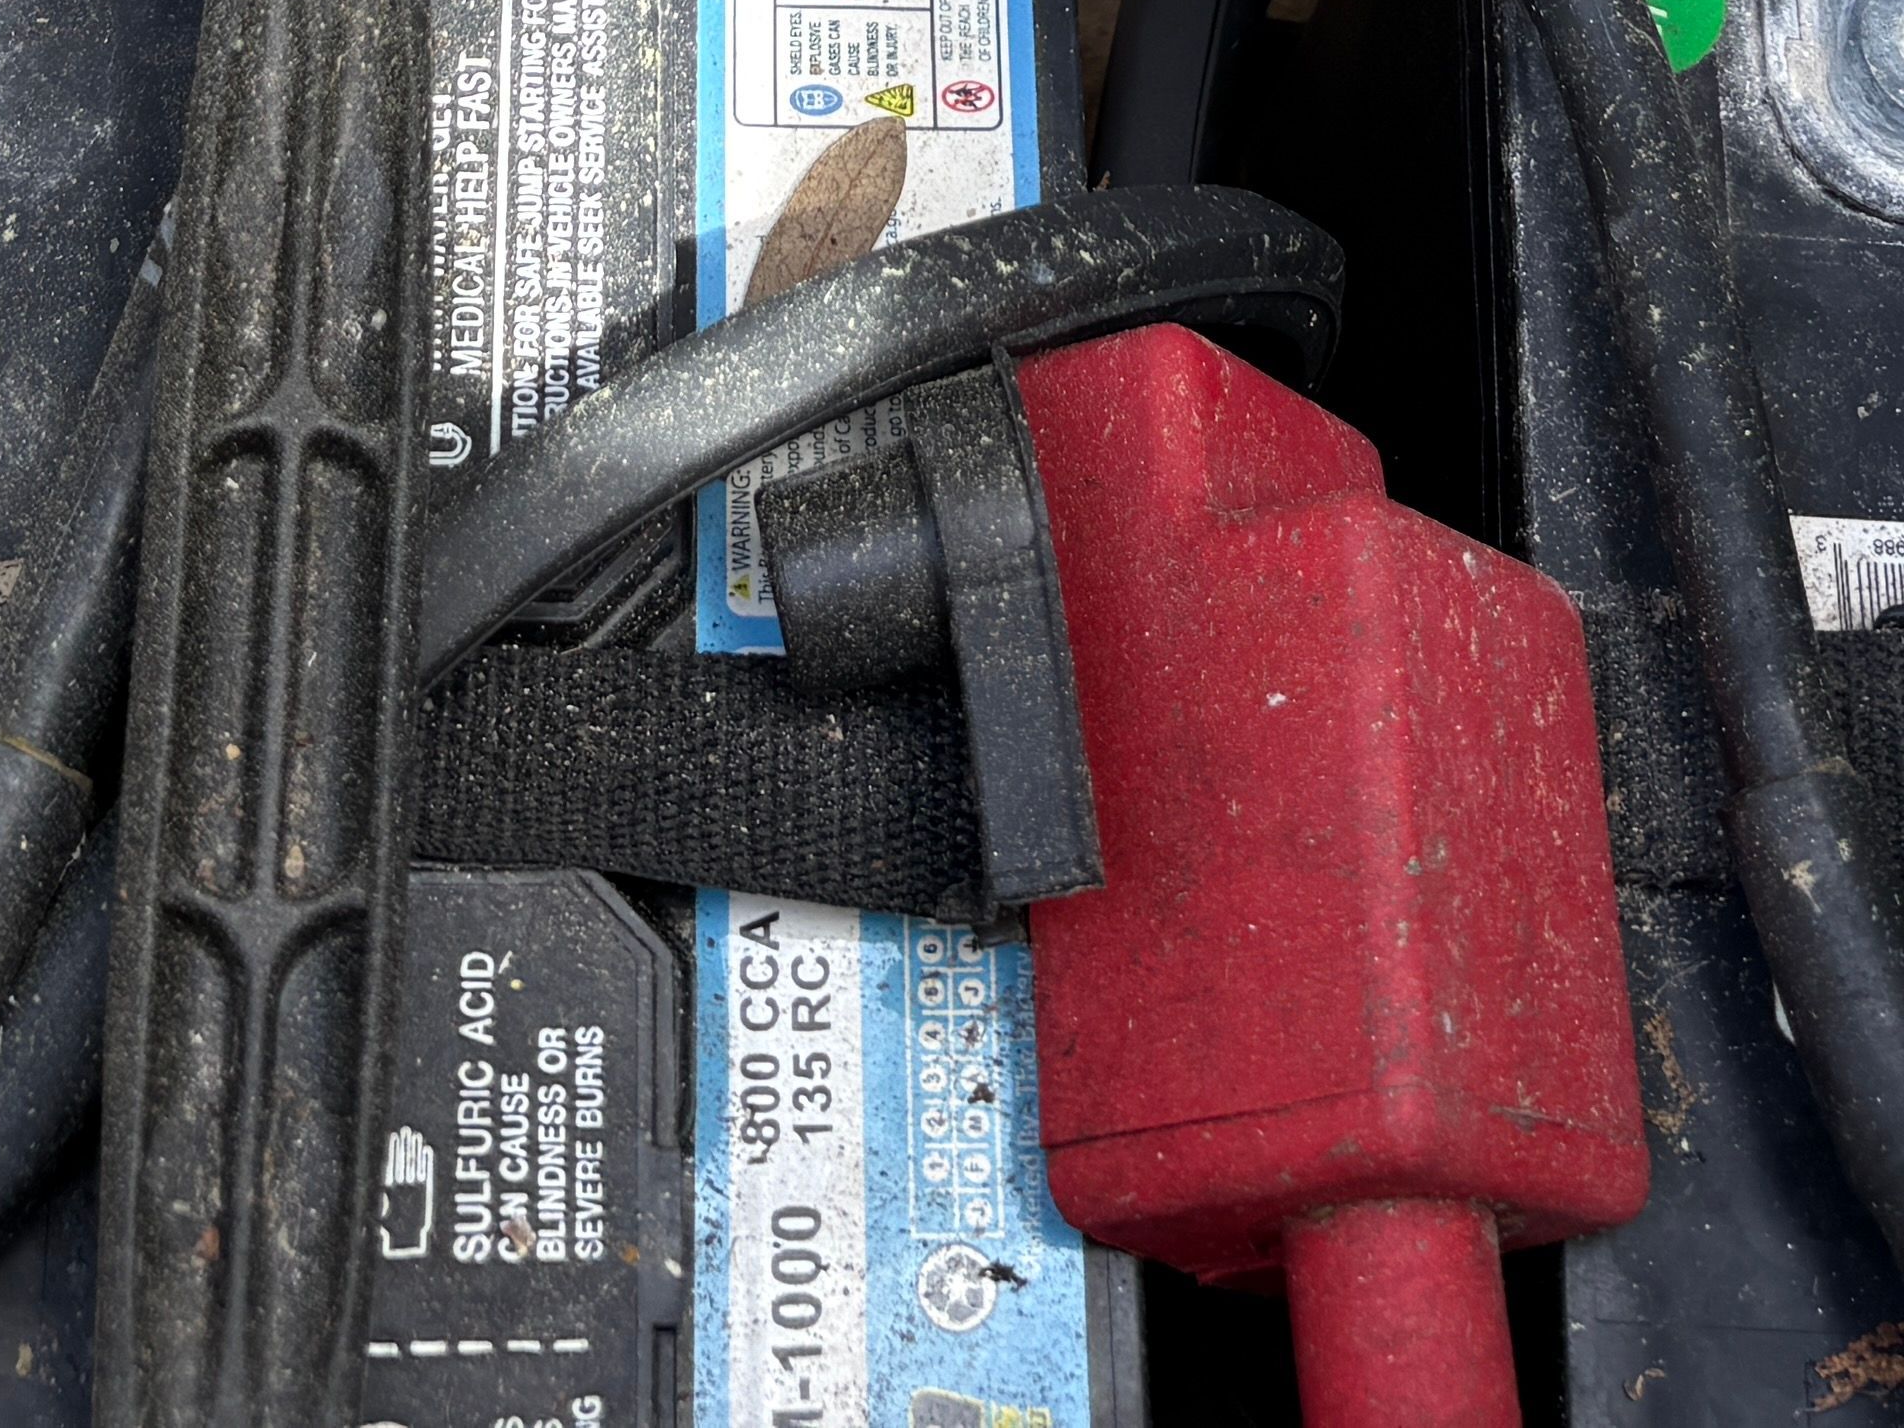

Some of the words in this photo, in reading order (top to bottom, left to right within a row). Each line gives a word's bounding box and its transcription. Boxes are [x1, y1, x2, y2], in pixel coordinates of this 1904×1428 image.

[455, 54, 491, 130] FAST
[517, 31, 548, 151] STARTING
[548, 39, 577, 146] OWNERS
[577, 84, 606, 187] SERVICE
[453, 142, 486, 226] HELP
[515, 158, 544, 228] JUMP
[547, 153, 575, 256] VEHICLE
[575, 191, 604, 255] SEEK
[450, 237, 486, 375] MEDICAL
[514, 235, 542, 296] SAFE
[513, 304, 540, 355] FOR
[572, 261, 604, 387] AVAILABLE
[1815, 535, 1826, 551] 3
[458, 950, 497, 1044] ACID
[736, 909, 783, 1031] CCA
[789, 954, 833, 1031] RC
[537, 1026, 568, 1073] OR
[572, 1025, 606, 1128] BURNS
[789, 1050, 834, 1144] 135
[497, 1072, 531, 1181] CAUSE
[737, 1053, 782, 1145] 800
[452, 1059, 497, 1255] SULFURIC
[532, 1082, 571, 1255] BLINDNESS
[572, 1139, 606, 1258] SEVERE
